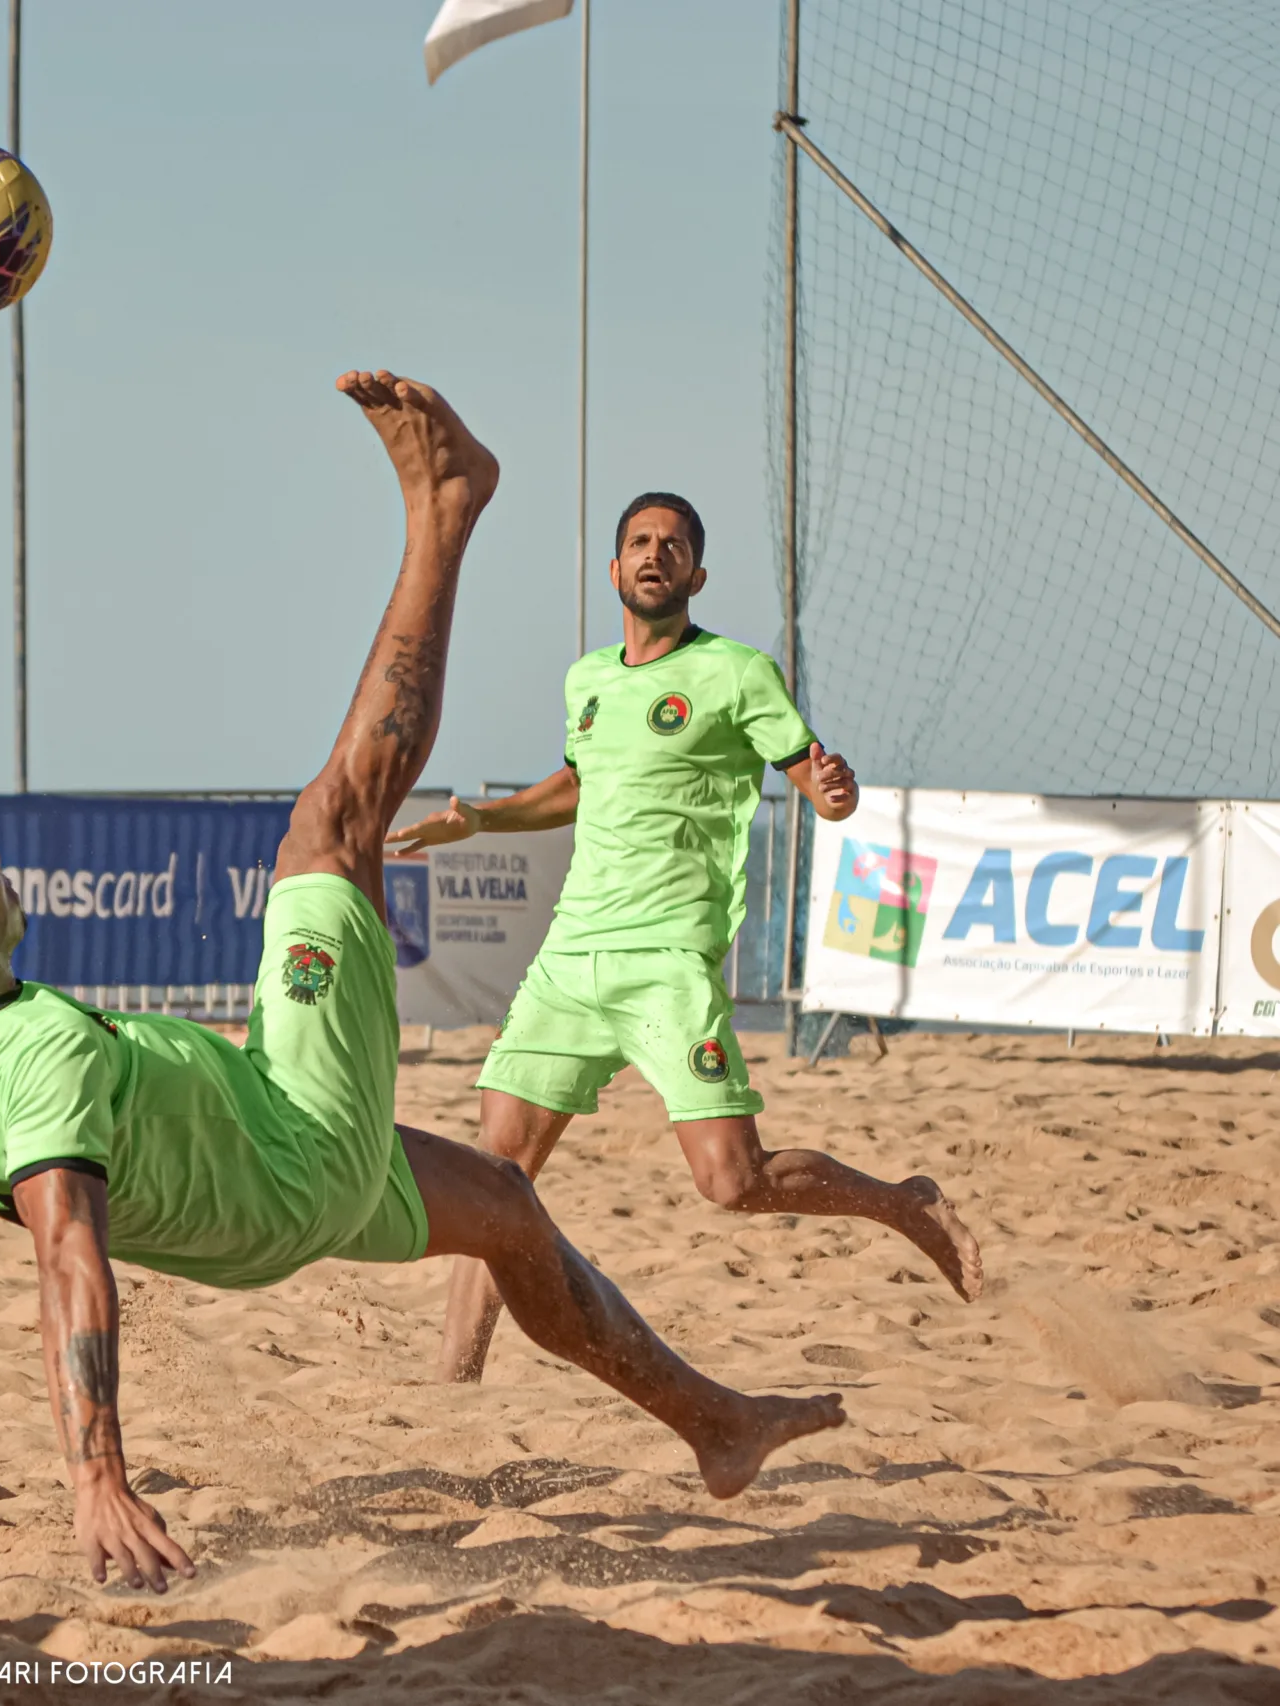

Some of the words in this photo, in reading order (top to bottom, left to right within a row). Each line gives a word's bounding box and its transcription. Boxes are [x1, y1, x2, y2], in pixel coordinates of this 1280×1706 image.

[436, 876, 473, 899] VILA
[476, 877, 528, 900] VELHA
[942, 847, 1206, 953] ACEL
[943, 955, 1012, 973] Associação
[1157, 966, 1191, 980] Lazer
